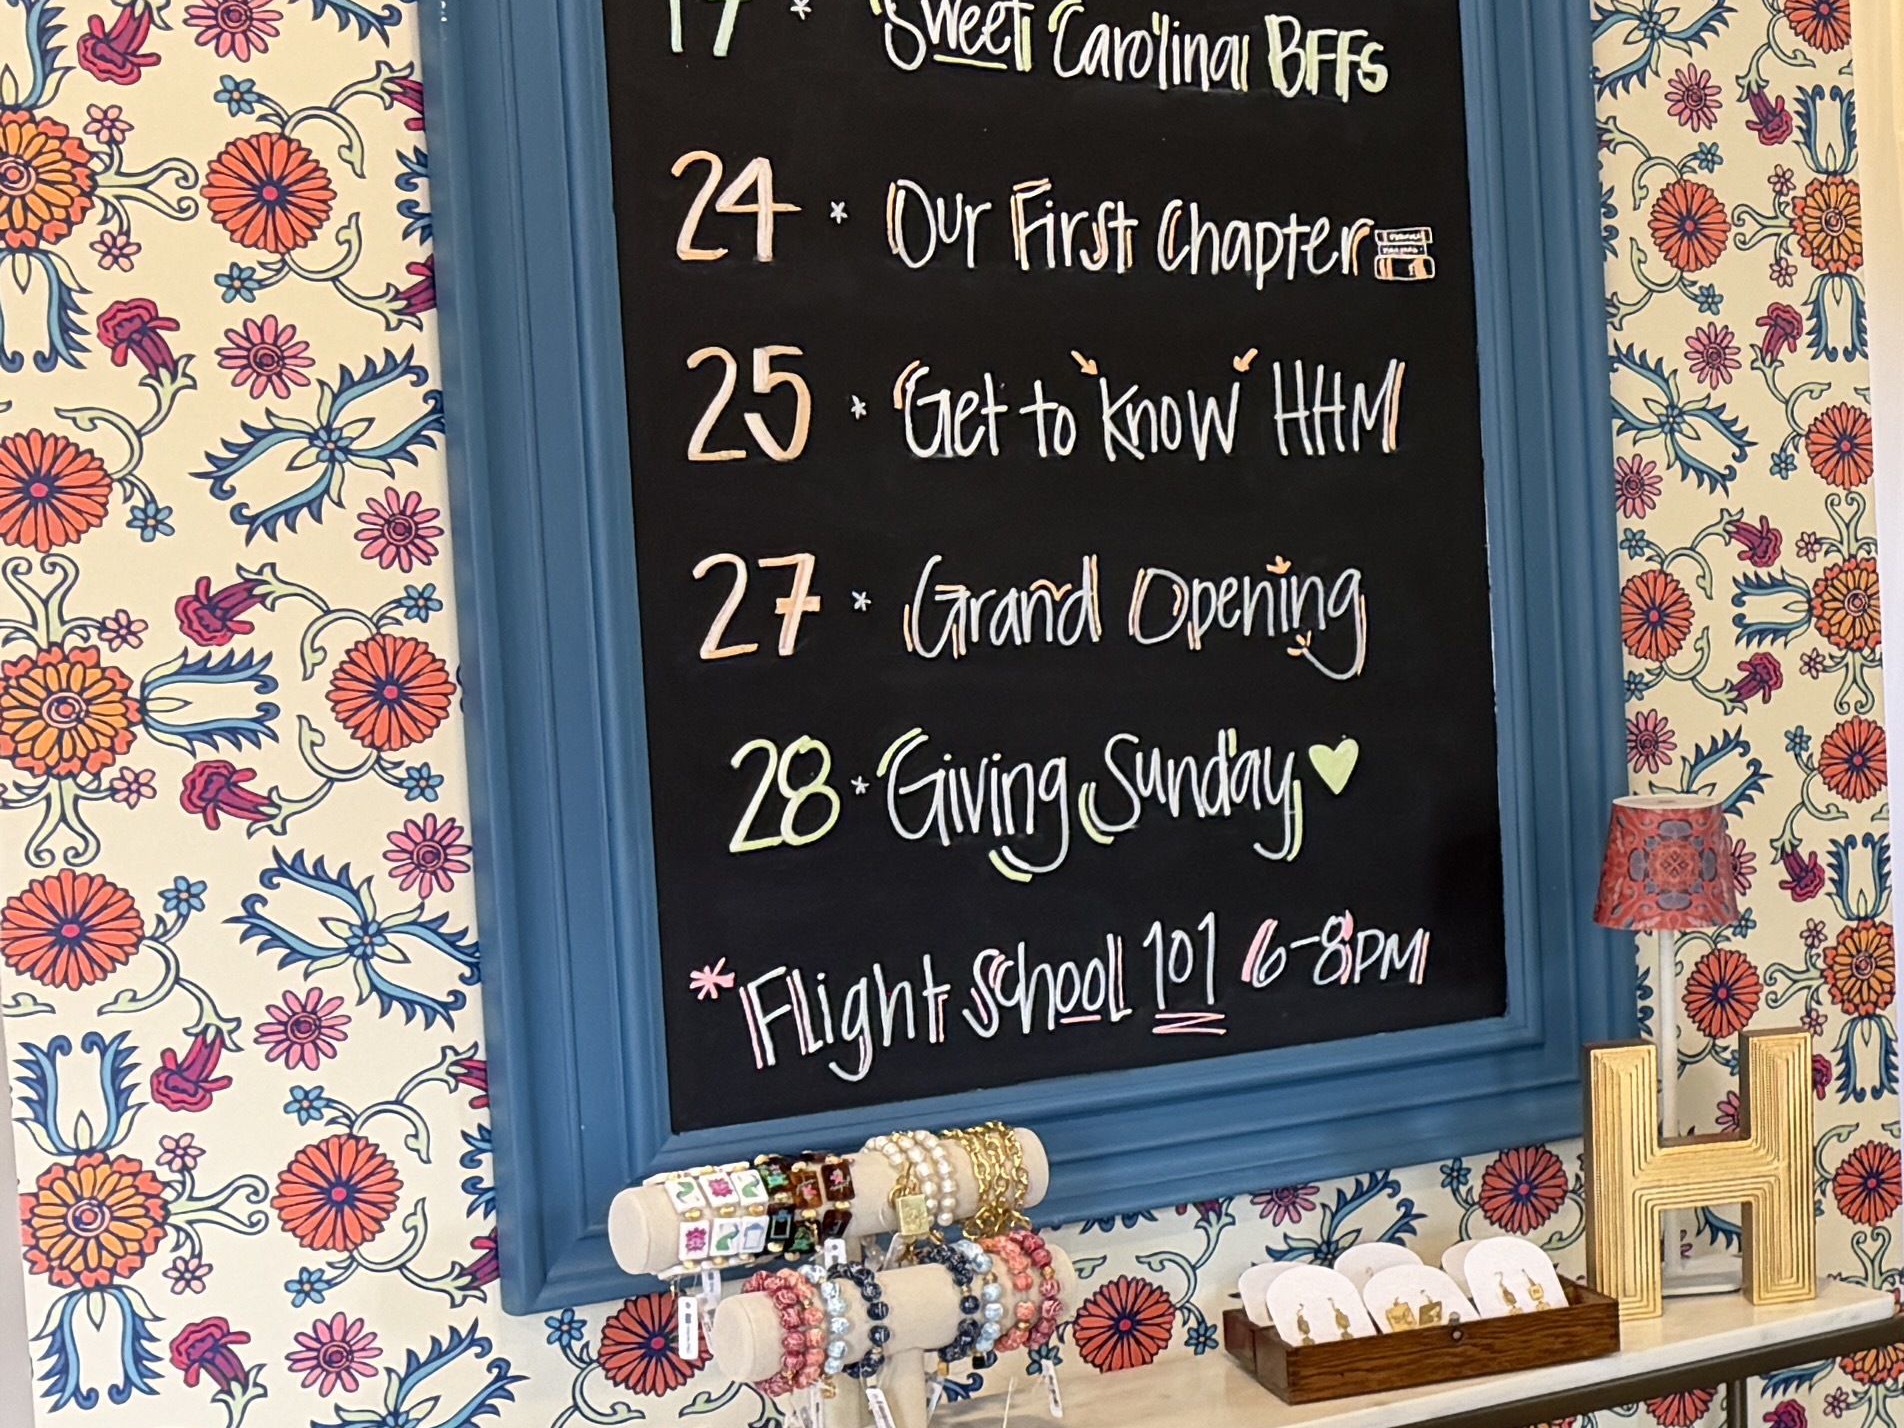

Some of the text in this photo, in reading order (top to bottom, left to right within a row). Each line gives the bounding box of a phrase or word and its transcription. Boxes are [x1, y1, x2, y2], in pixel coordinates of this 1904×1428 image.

[1264, 14, 1388, 103] BFFs
[671, 151, 1371, 290] 24 Our First Chapter
[687, 345, 811, 461] 25
[893, 360, 1008, 458] Get
[1019, 380, 1076, 457] to
[1273, 359, 1405, 456] HHM
[693, 553, 1366, 679] 27 Grand Opening
[729, 728, 1303, 882] 28 Giving Sunday
[1143, 912, 1226, 1035] 101
